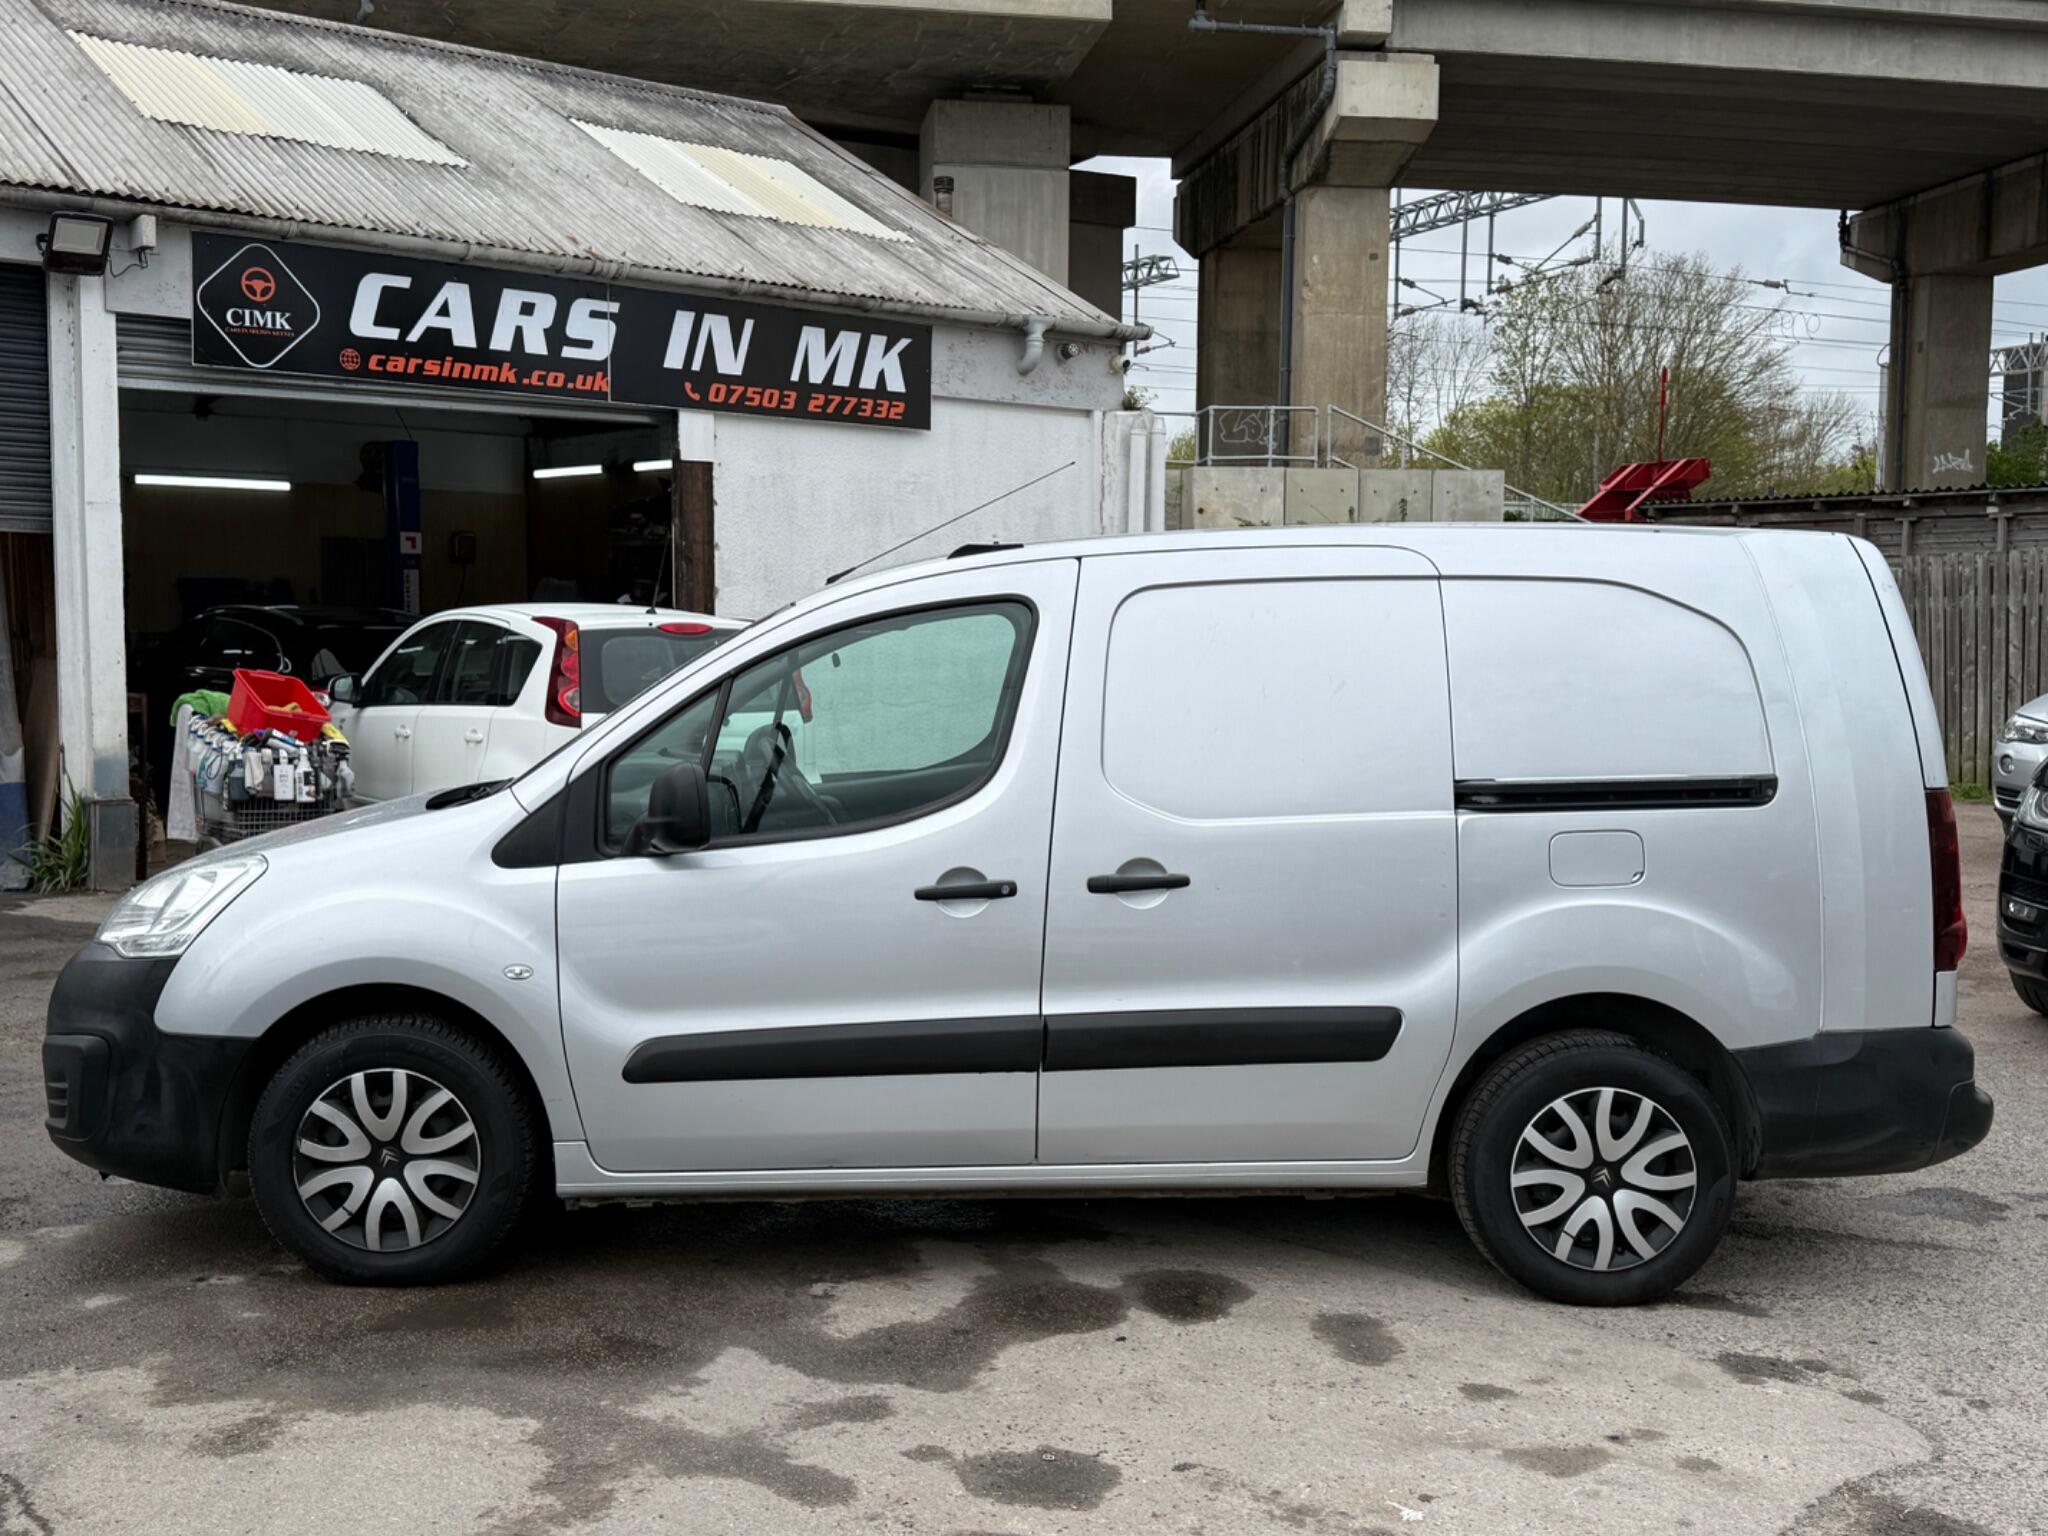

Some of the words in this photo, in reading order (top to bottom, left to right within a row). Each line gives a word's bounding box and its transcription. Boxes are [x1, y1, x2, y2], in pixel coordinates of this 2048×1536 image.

[226, 307, 293, 330] CIMK
[349, 272, 621, 362] CARS
[663, 309, 755, 376] IN
[789, 325, 913, 393] MK
[368, 354, 610, 393] carsinmk.co.uk
[708, 383, 797, 411] 07503
[807, 392, 906, 421] 277332
